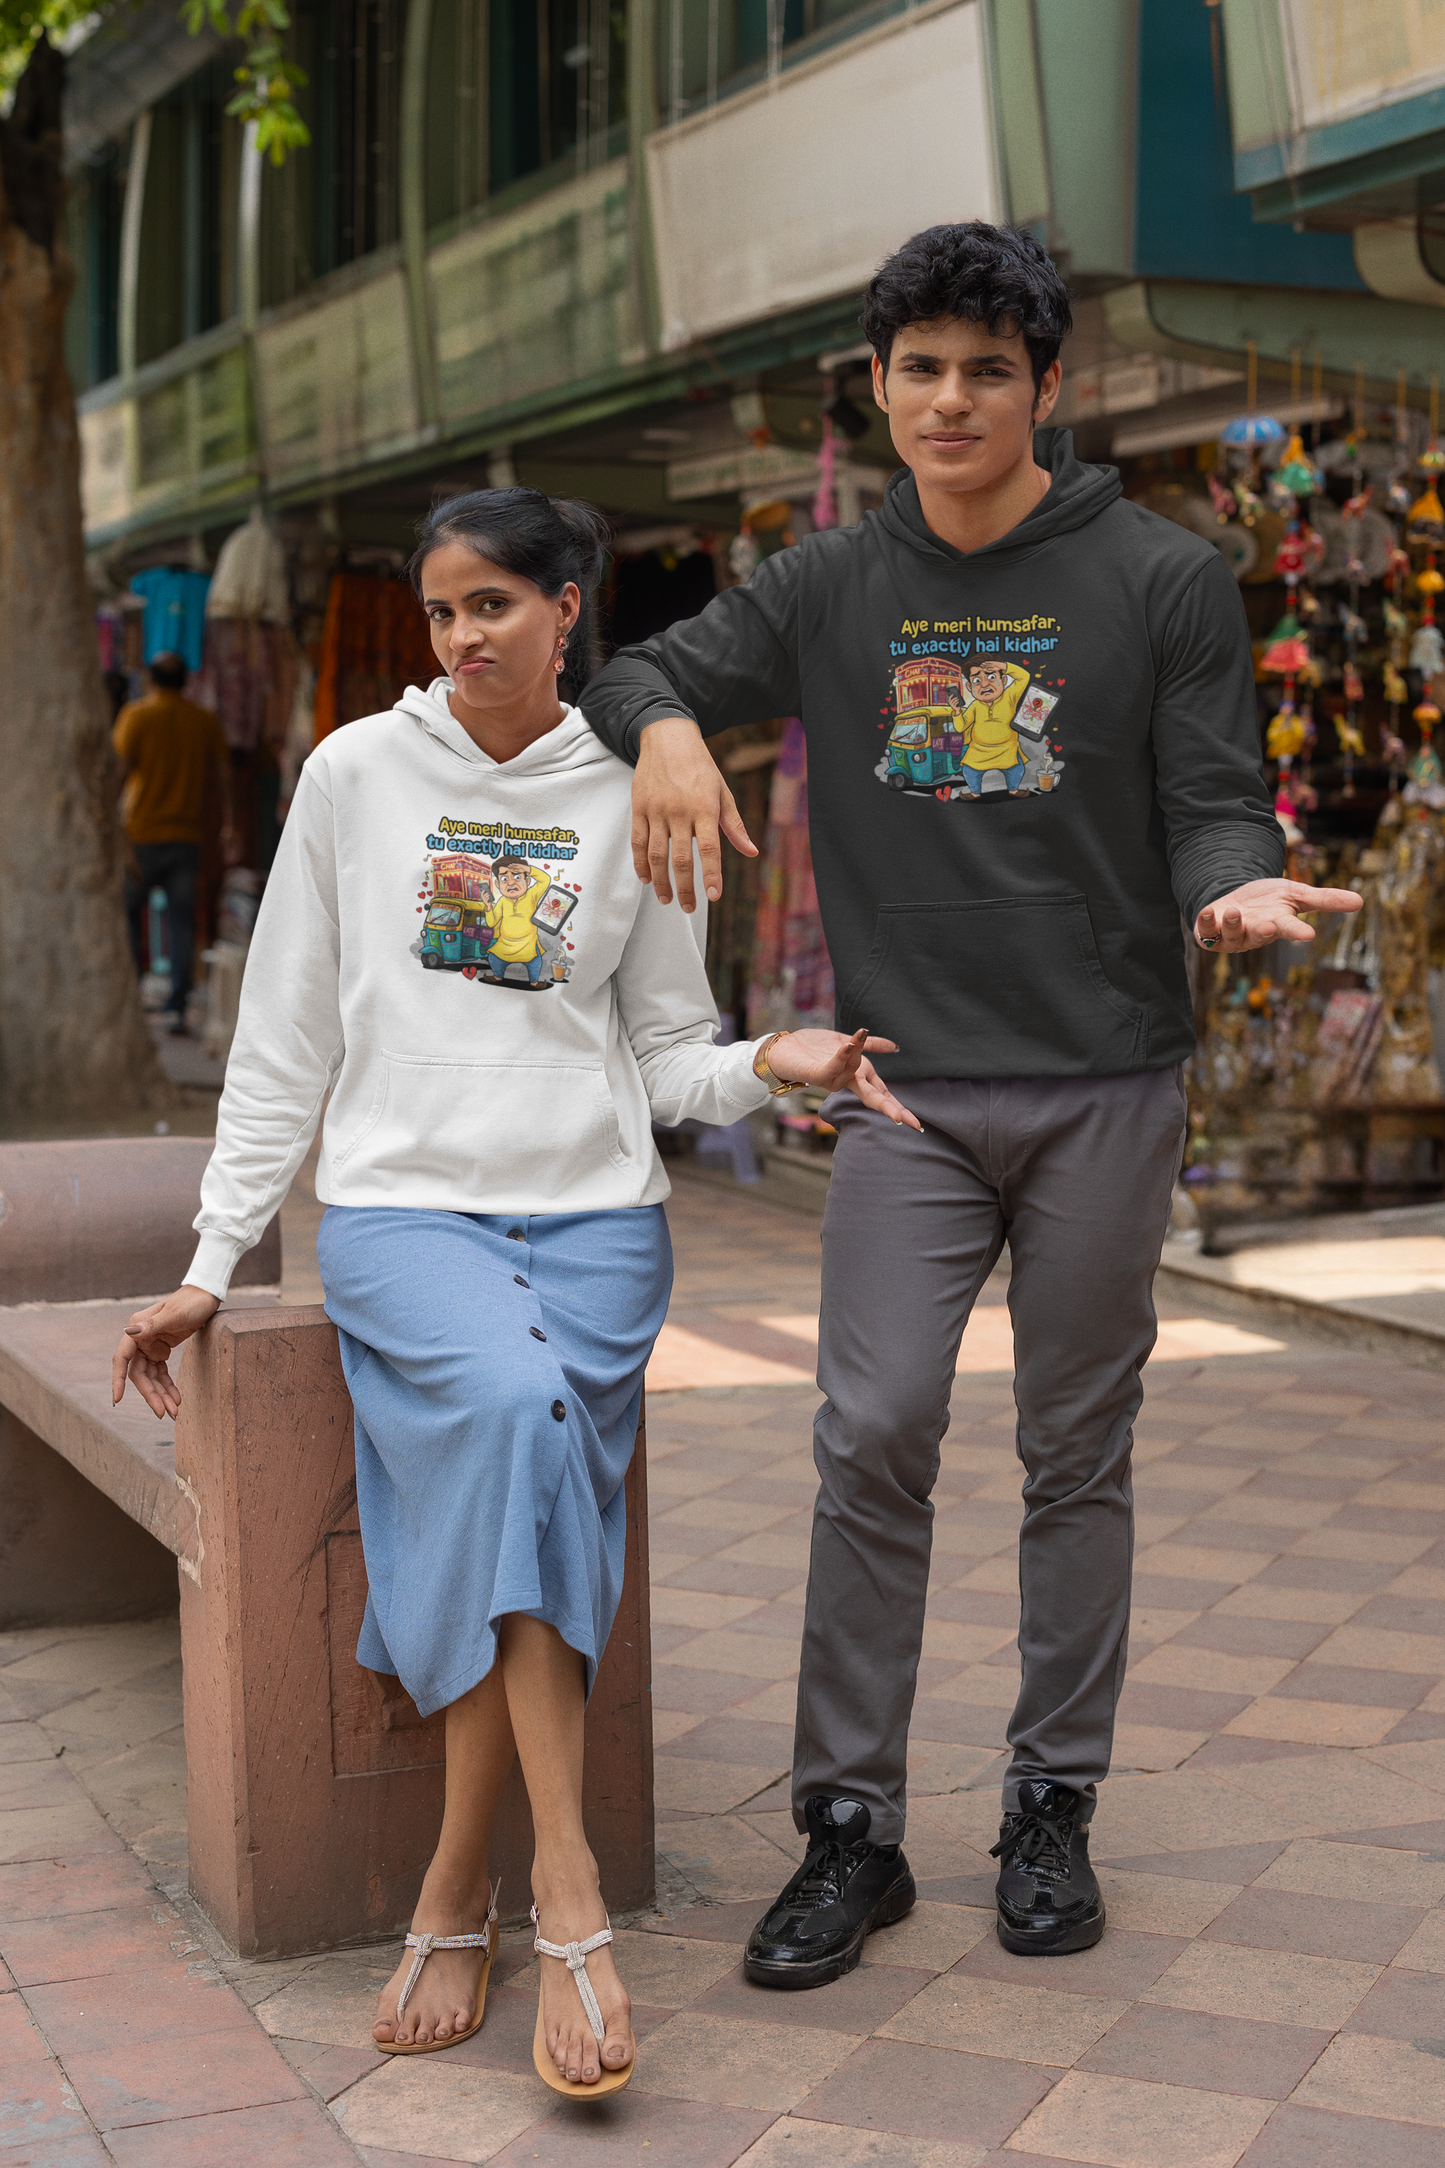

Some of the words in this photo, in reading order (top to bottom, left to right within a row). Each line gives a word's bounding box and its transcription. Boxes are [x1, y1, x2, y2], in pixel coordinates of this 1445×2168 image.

[901, 619, 929, 639] Aye
[933, 617, 971, 634] meri
[976, 614, 1061, 633] humsafar,
[889, 640, 907, 656] tu
[911, 637, 971, 658] exactly
[975, 636, 1000, 653] hai
[1004, 636, 1059, 653] kidhar
[439, 817, 466, 836] Aye
[469, 822, 502, 837] meri
[505, 824, 579, 844] humsafar,
[427, 835, 444, 849] tu
[448, 839, 501, 858] exactly
[504, 842, 525, 857] hai
[529, 843, 577, 859] kidhar
